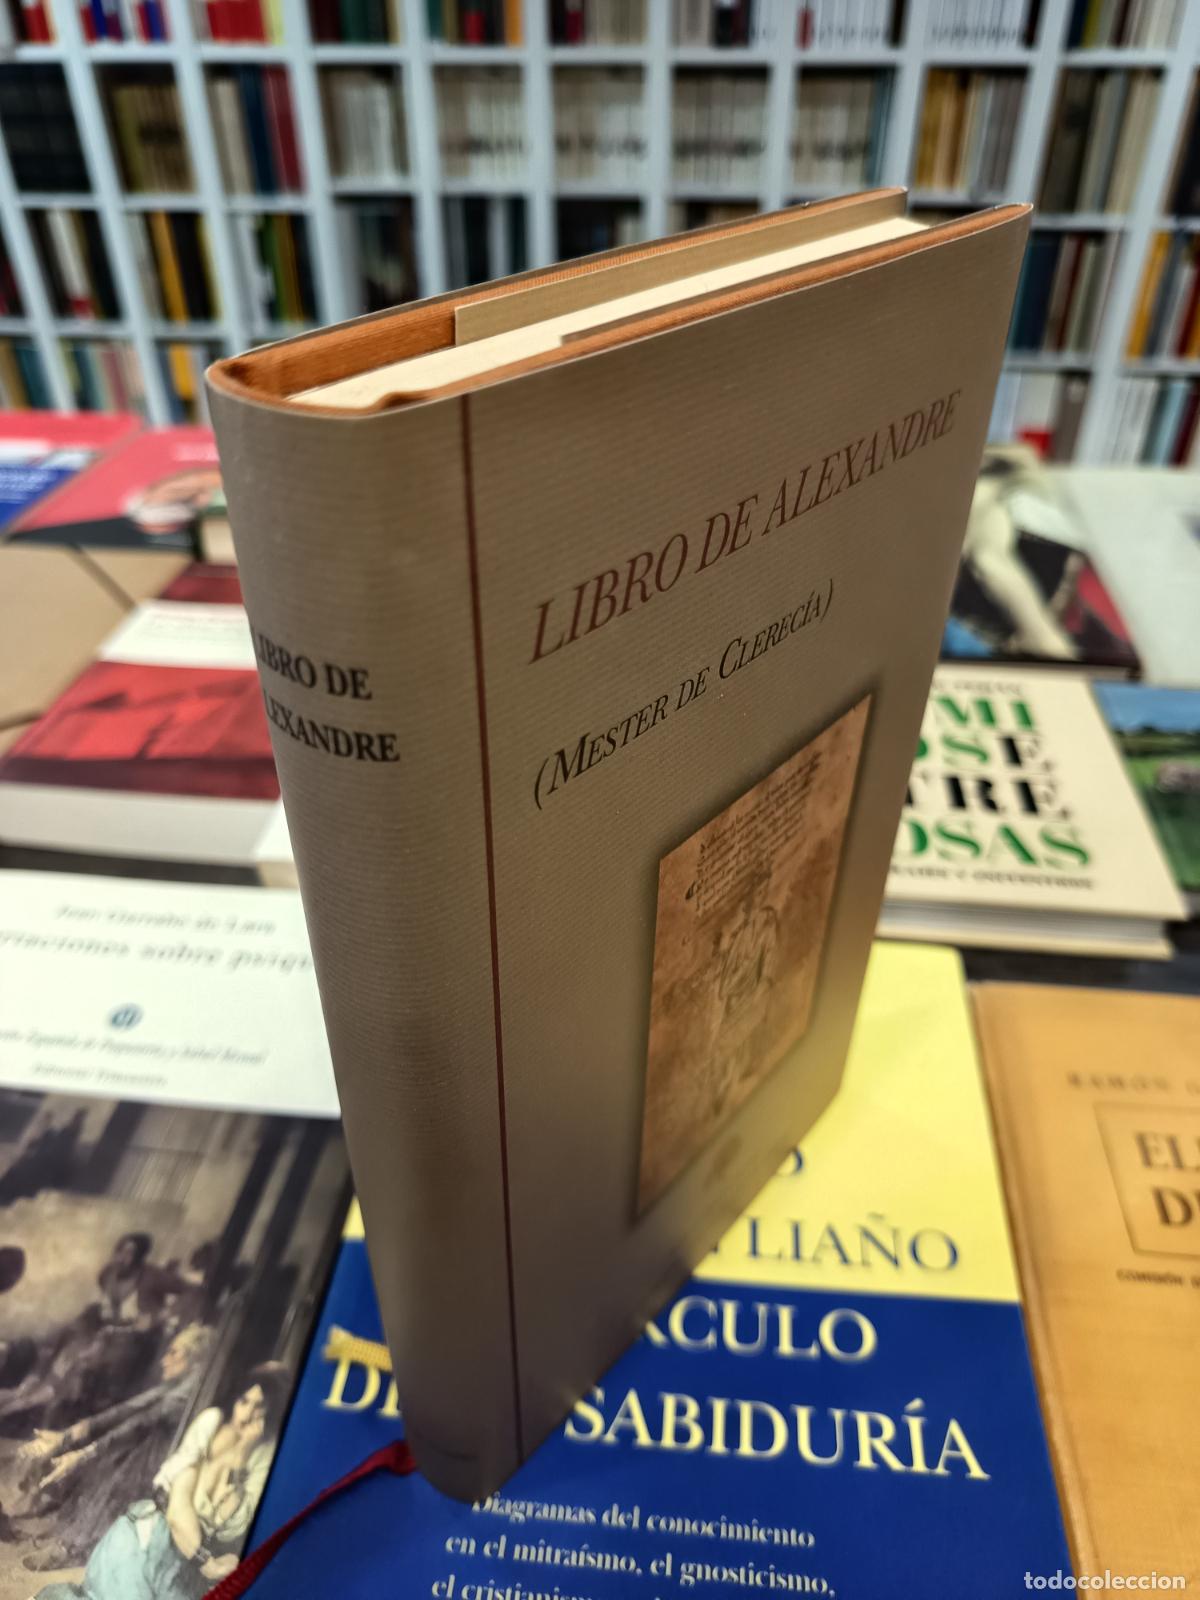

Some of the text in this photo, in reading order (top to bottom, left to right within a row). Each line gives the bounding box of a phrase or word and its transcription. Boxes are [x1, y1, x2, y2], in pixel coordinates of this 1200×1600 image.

[529, 389, 962, 665] LIBRO DE ALEXANDRE
[252, 624, 317, 690] IBRO
[325, 661, 373, 701] DE
[747, 1211, 959, 1273] LIAÑO
[563, 1386, 991, 1481] SABIDURÍA
[472, 1490, 817, 1548] Diagramas del conocimiento
[431, 1574, 456, 1600] el
[445, 1533, 837, 1598] en el mitraísmo, el gnosticismo,
